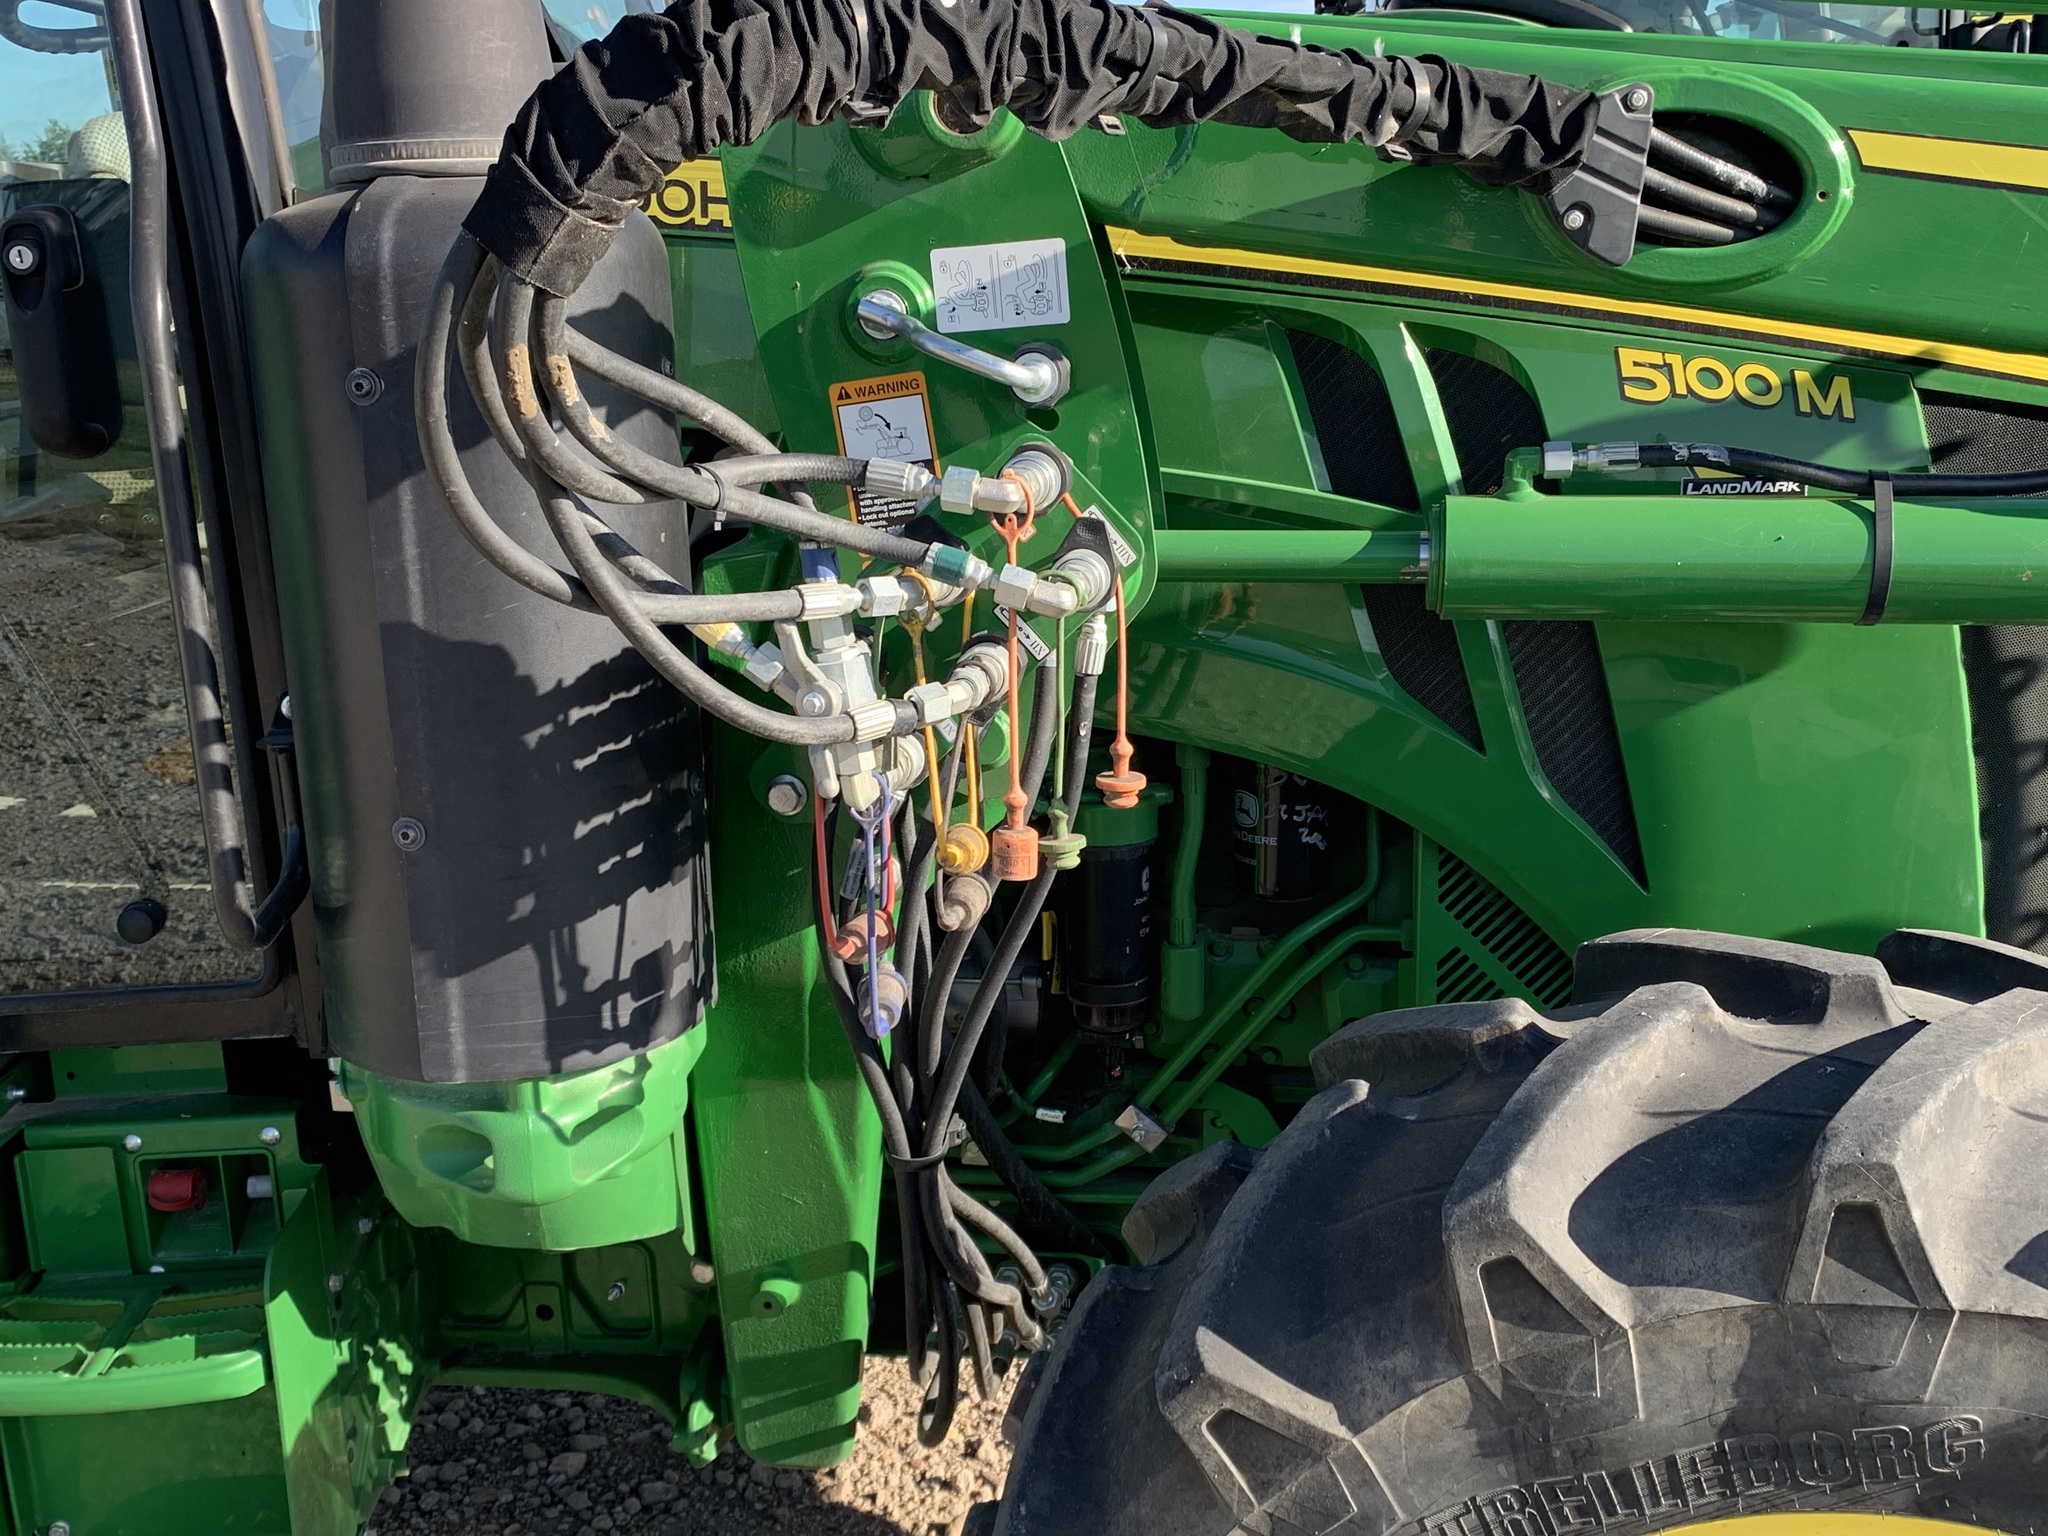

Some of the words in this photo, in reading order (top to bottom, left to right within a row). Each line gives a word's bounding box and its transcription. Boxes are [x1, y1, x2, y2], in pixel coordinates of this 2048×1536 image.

[854, 378, 920, 398] WARNING
[1615, 347, 1784, 406] 5100
[1791, 369, 1856, 421] M
[859, 498, 873, 506] with
[861, 505, 888, 514] handling
[862, 512, 878, 520] Lock
[878, 511, 889, 519] out
[890, 508, 915, 518] optional
[1241, 831, 1278, 846] DEERE
[1421, 1415, 1985, 1536] TRELLEBORG
